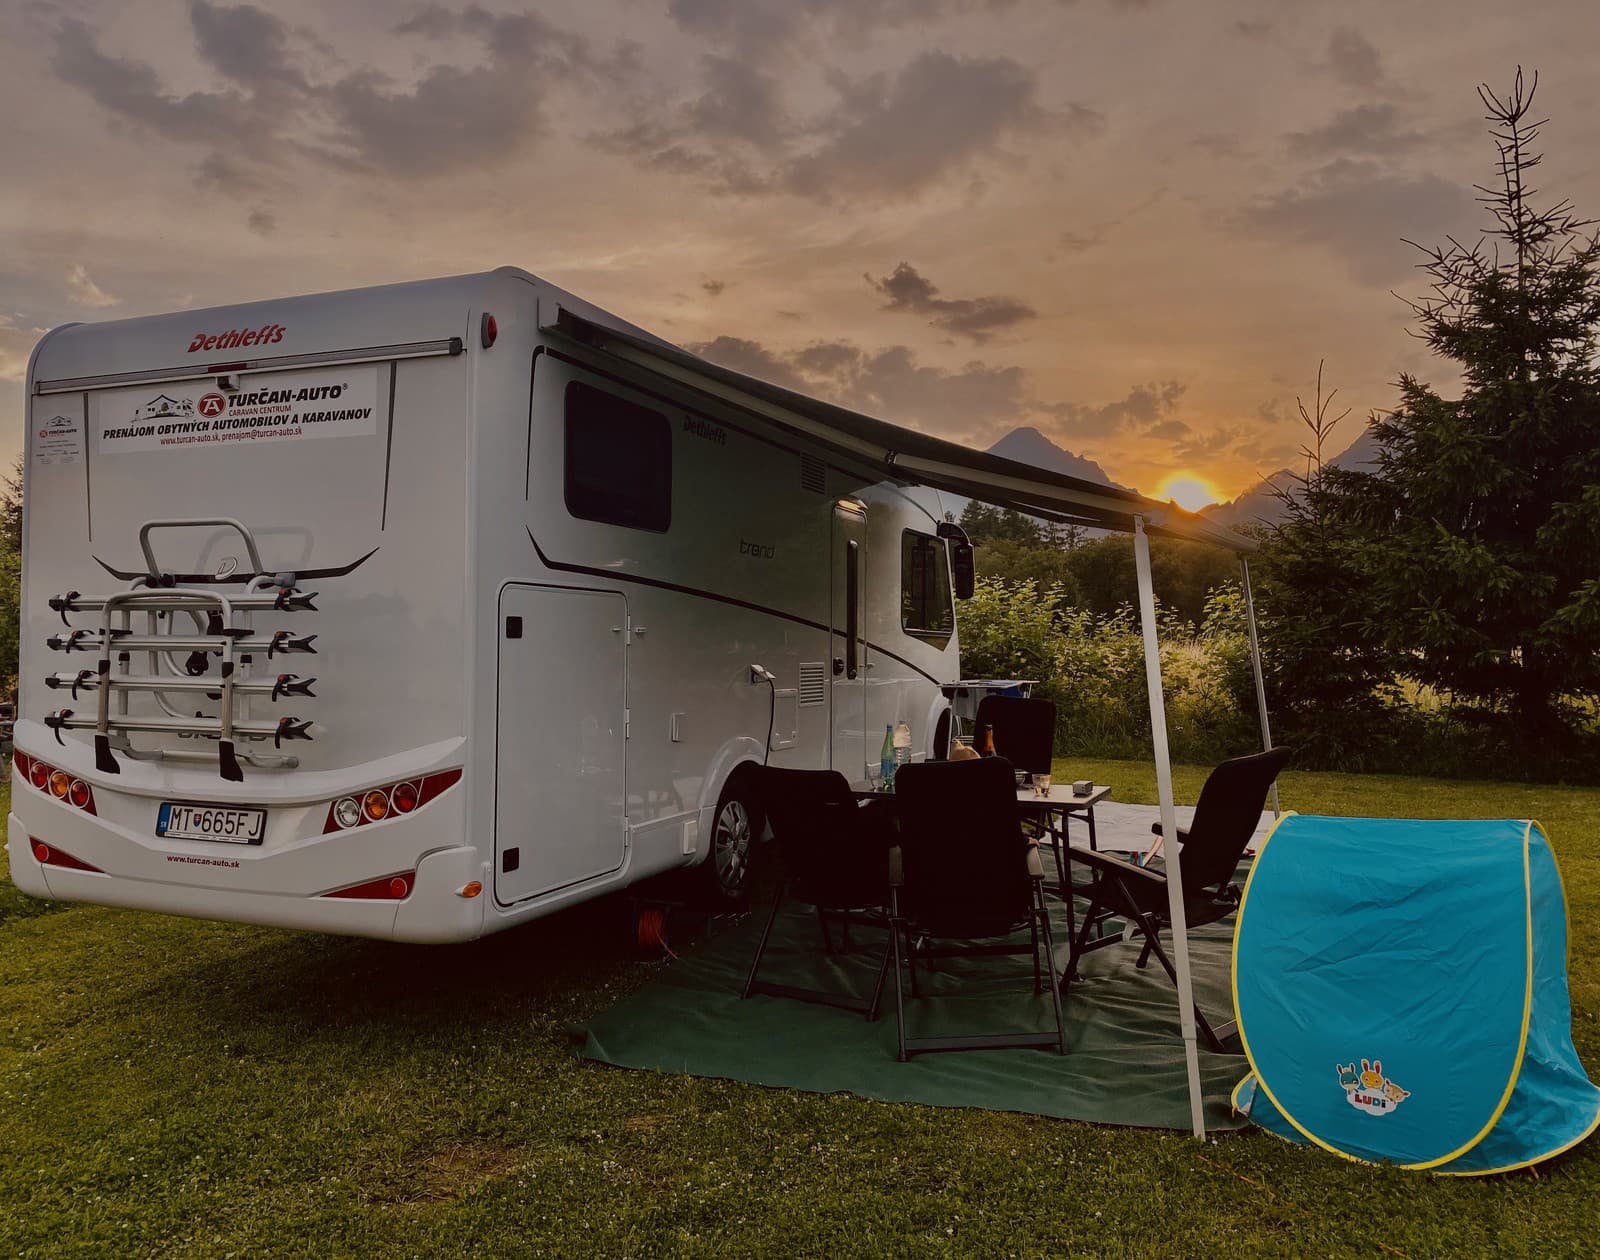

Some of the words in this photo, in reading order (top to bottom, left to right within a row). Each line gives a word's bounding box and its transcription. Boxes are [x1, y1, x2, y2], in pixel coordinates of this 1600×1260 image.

[187, 324, 287, 352] Dethleffs
[228, 407, 259, 417] CARAVAN
[260, 405, 292, 415] CENTRUM
[103, 425, 155, 439] PRENÁJOM
[157, 419, 210, 435] OBYTNÝCH
[212, 414, 290, 430] AUTOMOBILOV
[291, 414, 299, 425] A
[302, 408, 372, 423] KARAVANOV
[222, 426, 303, 441] prenajom@turcan-auto.sk
[738, 538, 776, 560] trend
[166, 855, 240, 869] www.turcan-auto.sk
